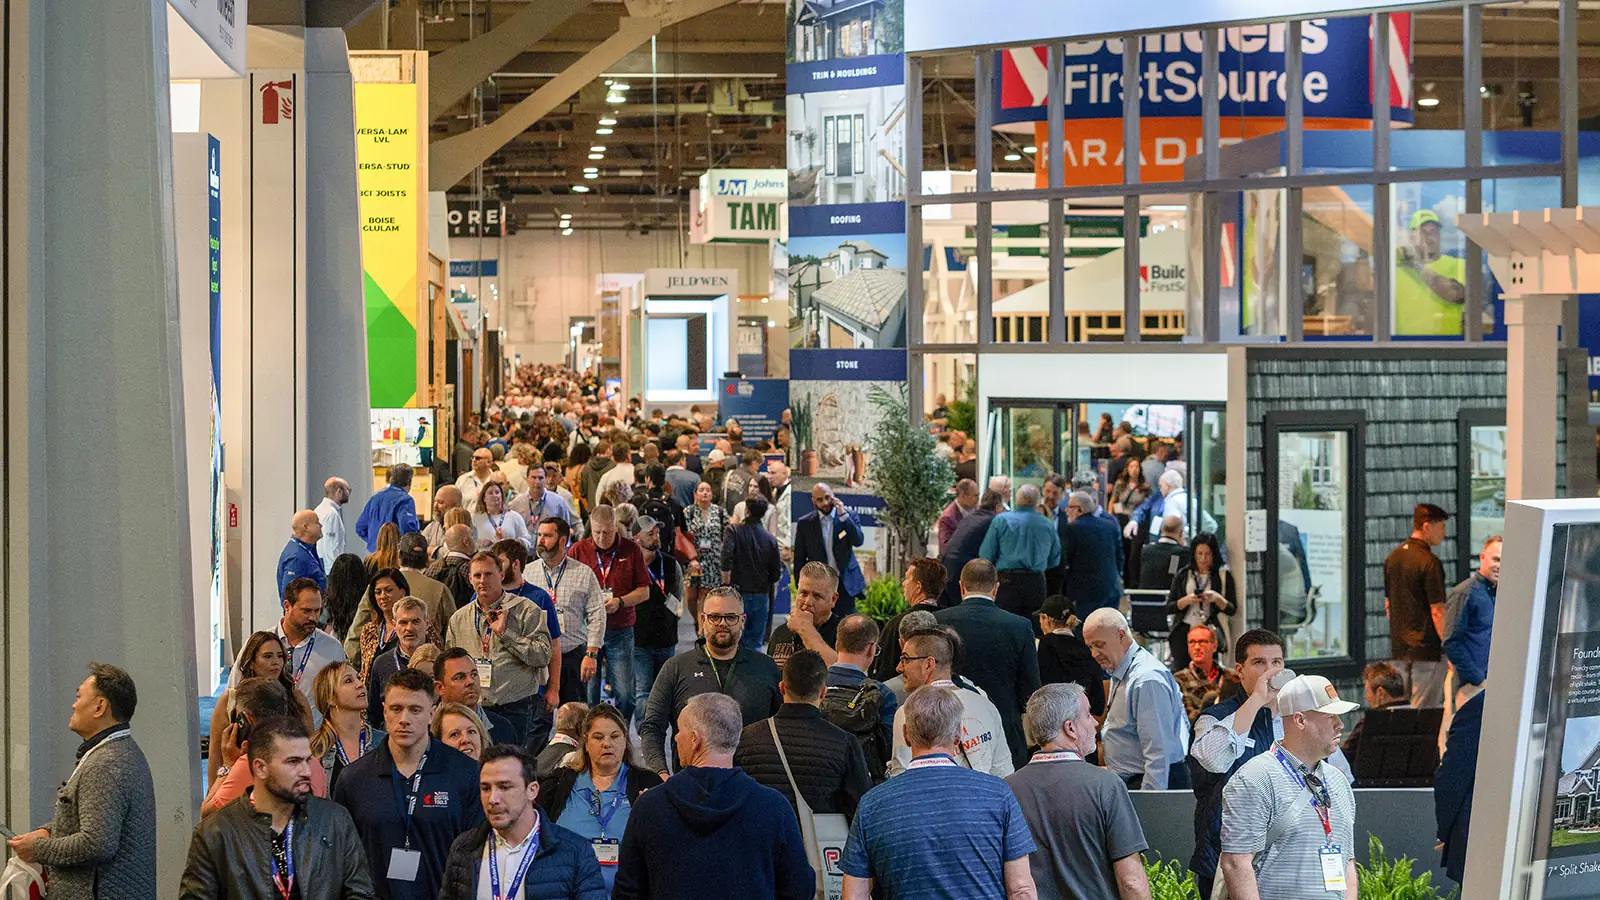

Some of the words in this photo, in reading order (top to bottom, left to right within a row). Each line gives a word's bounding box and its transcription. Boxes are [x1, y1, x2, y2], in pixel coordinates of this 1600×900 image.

[812, 71, 829, 80] TRIM
[830, 70, 836, 78] &
[837, 66, 877, 78] MOULDINGS
[717, 179, 747, 195] JM
[752, 180, 785, 189] Johns
[830, 215, 861, 224] ROOFING
[836, 360, 859, 369] STONE
[1560, 864, 1578, 879] Split
